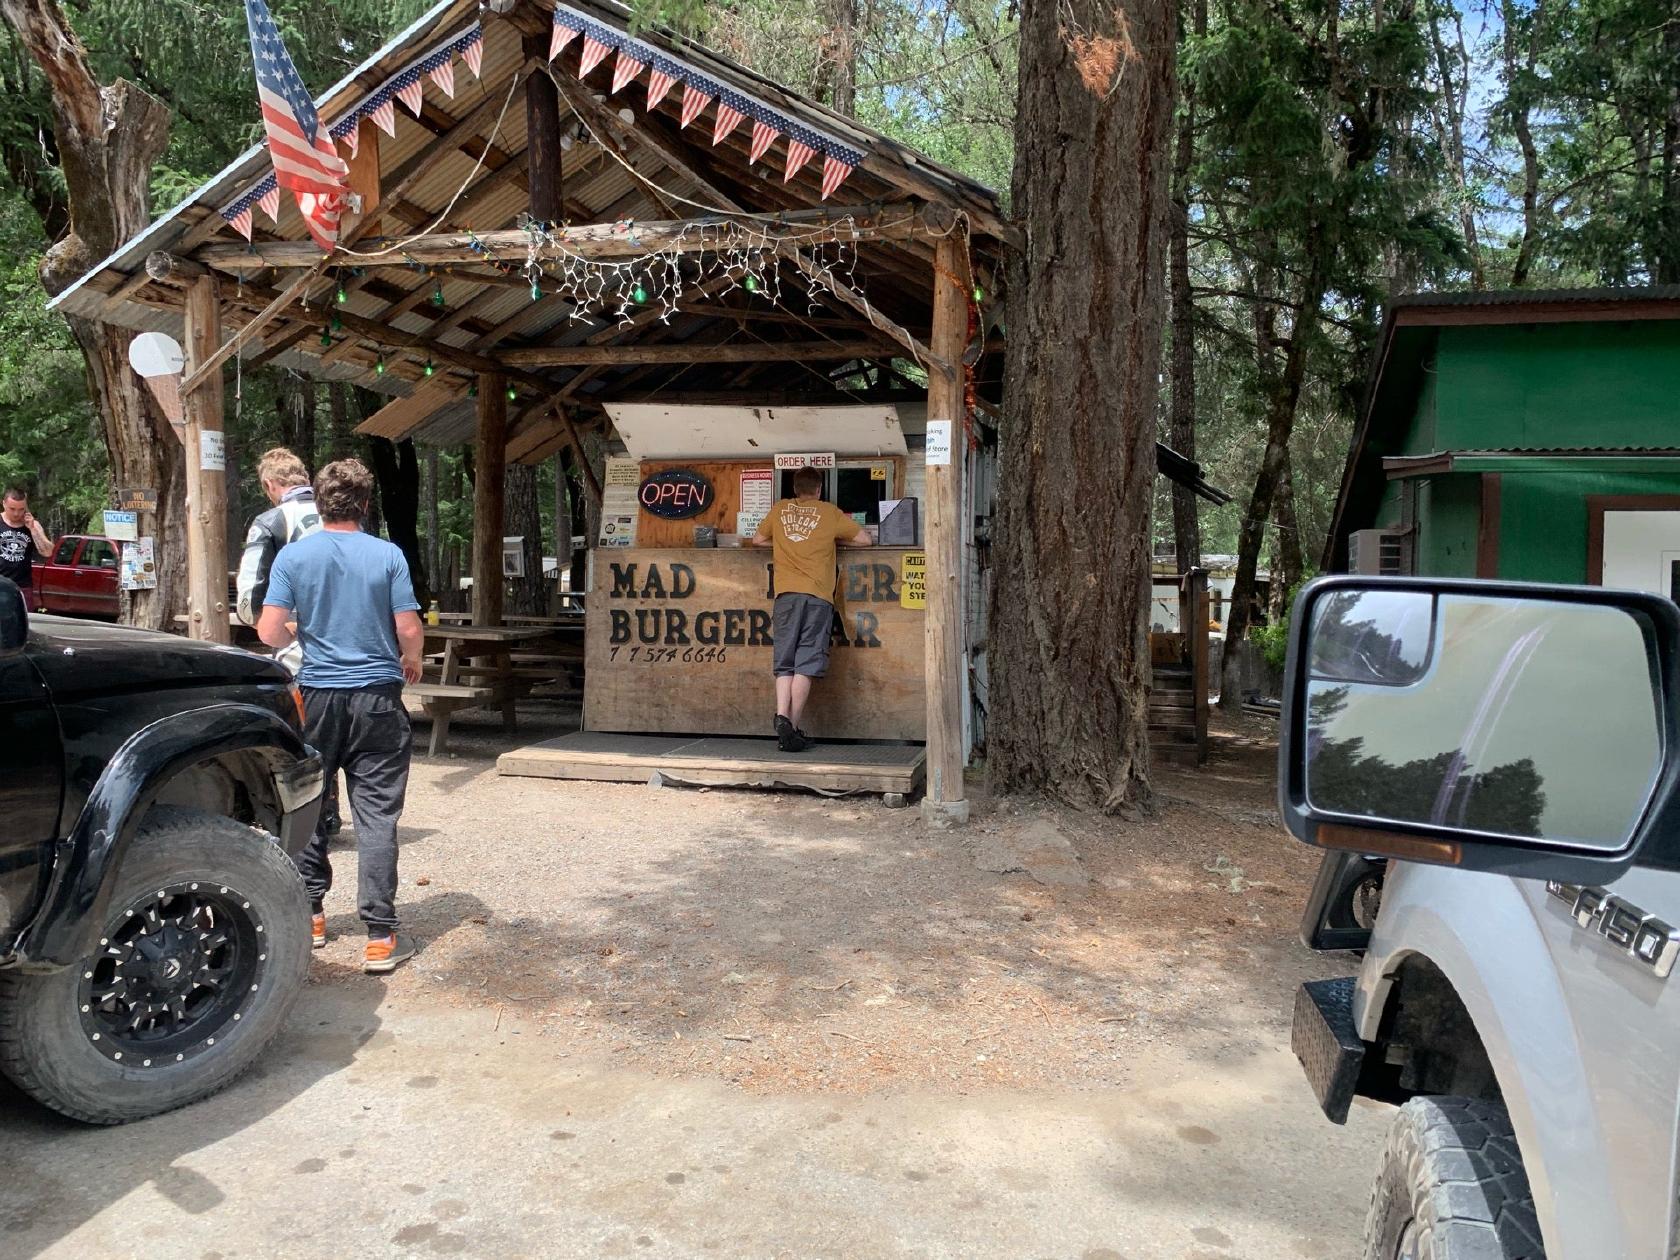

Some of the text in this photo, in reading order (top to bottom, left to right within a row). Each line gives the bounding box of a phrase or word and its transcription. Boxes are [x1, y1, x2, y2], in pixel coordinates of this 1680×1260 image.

[777, 456, 832, 466] ORDER HERE
[133, 491, 145, 500] NO
[642, 483, 707, 507] OPEN
[105, 513, 136, 523] NOTICE
[781, 513, 818, 530] VOLCOM
[906, 556, 925, 565] CAUT
[906, 571, 926, 579] WAT
[609, 563, 696, 599] MAD
[909, 582, 926, 590] YOU
[909, 592, 926, 600] STE
[609, 609, 774, 646] BURGER
[643, 647, 678, 663] 574
[682, 647, 727, 663] 6646
